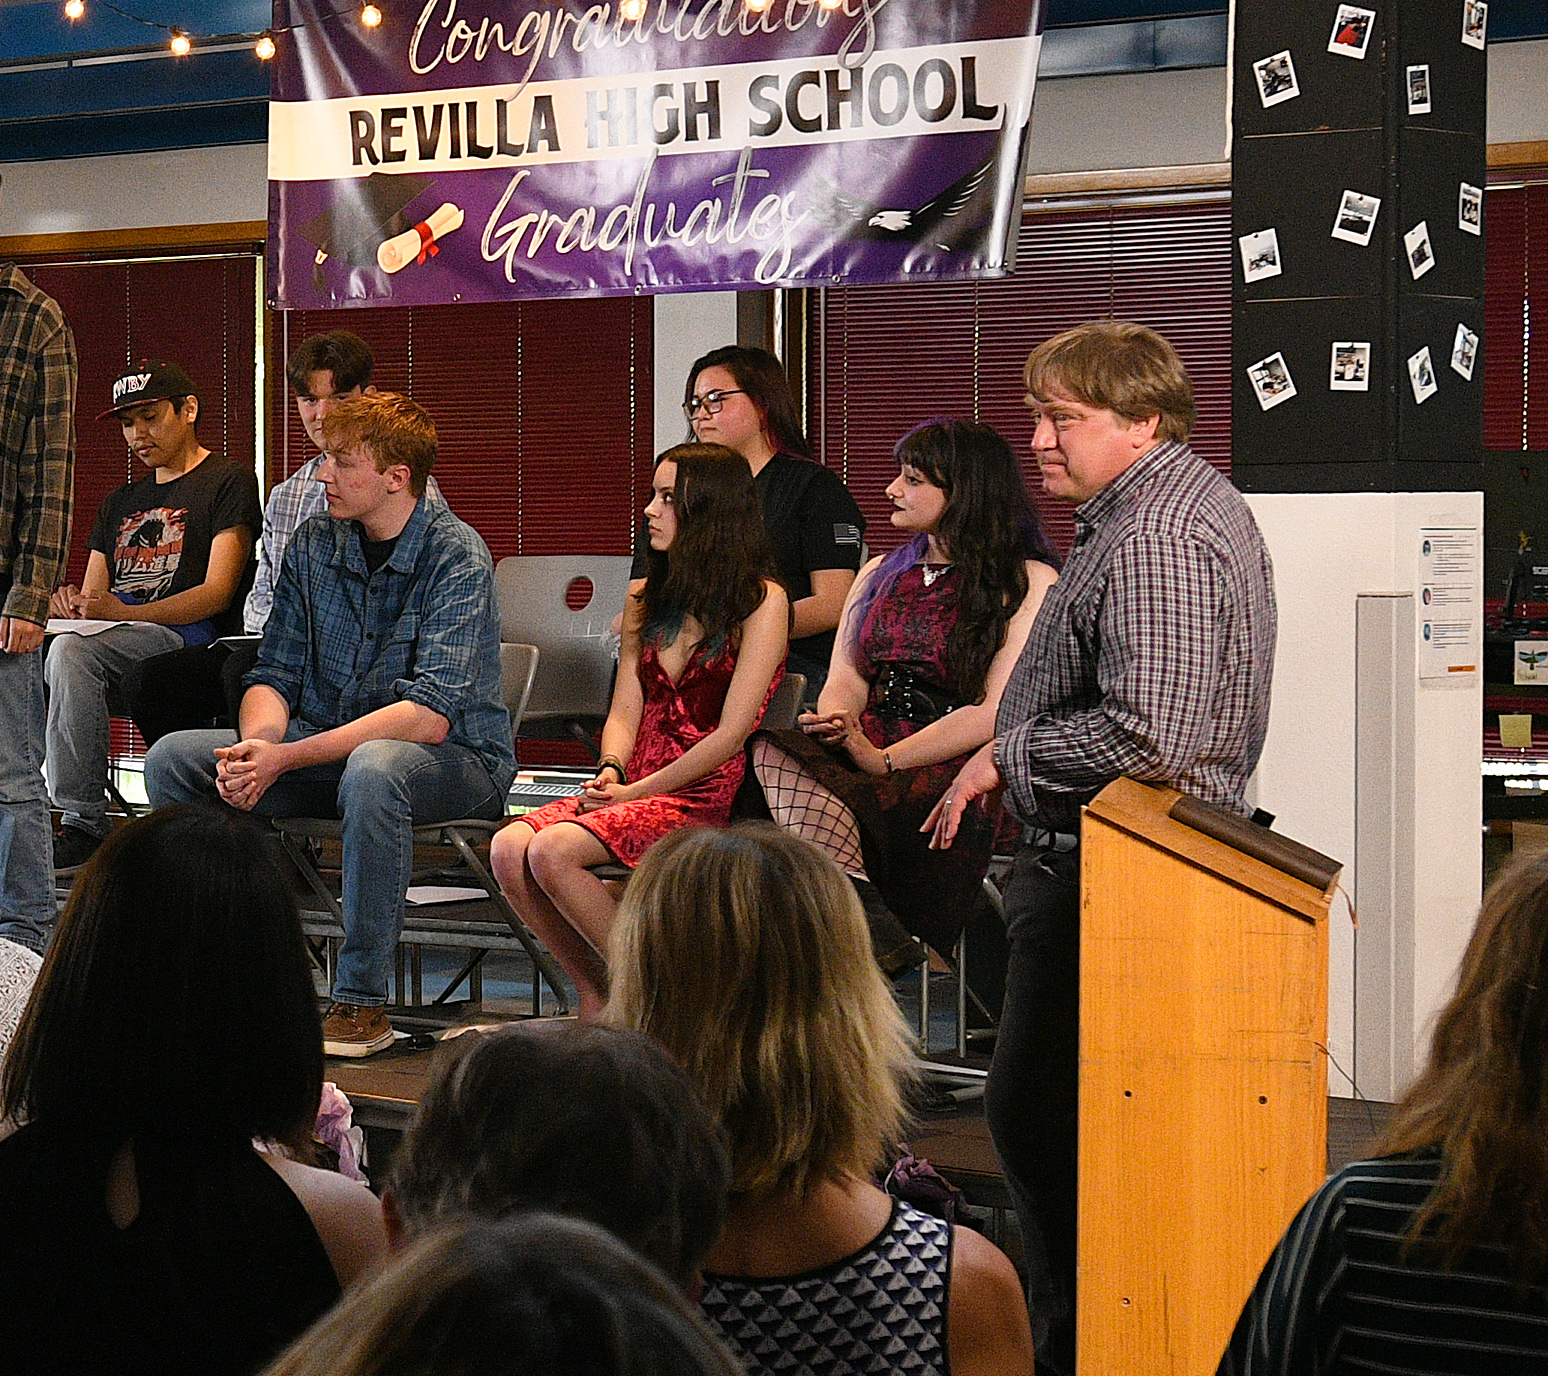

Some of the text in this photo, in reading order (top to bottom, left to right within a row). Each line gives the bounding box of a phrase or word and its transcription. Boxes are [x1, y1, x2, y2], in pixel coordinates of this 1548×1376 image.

[349, 55, 996, 167] REVILLA HIGH SCHOOL
[480, 146, 810, 284] Graduates
